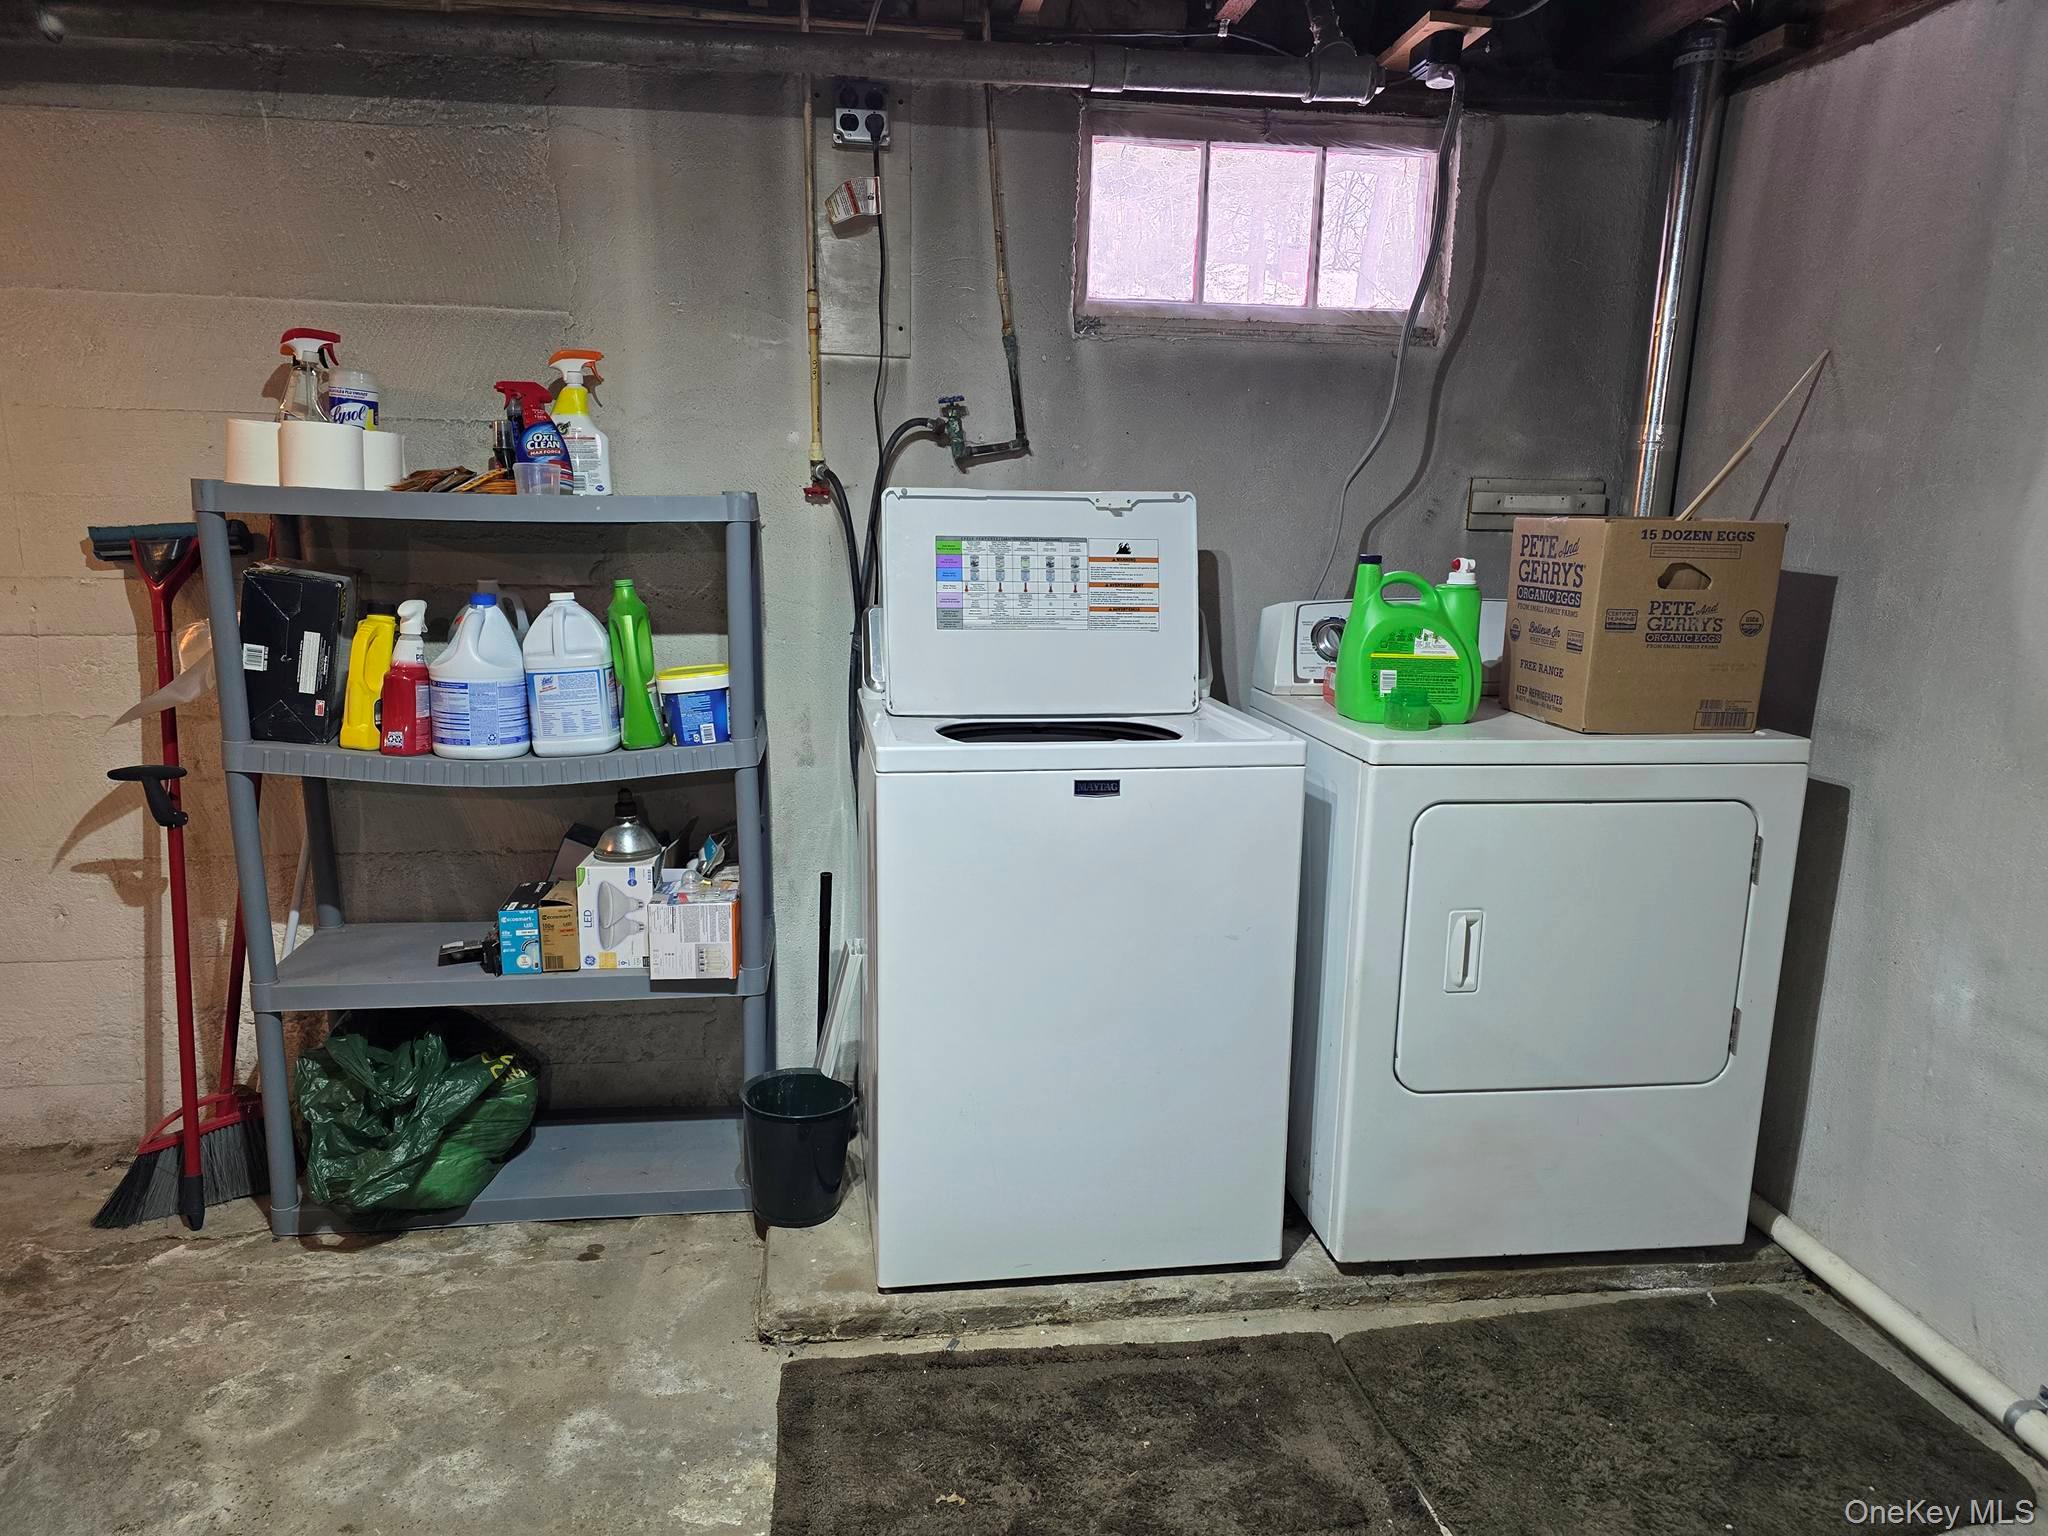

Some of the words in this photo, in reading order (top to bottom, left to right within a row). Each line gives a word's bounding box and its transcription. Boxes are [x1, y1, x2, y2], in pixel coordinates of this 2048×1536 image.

[532, 432, 555, 442] OXI
[526, 440, 560, 450] CLEAN
[1641, 529, 1658, 540] 15
[1661, 530, 1713, 541] DOZEN
[1717, 531, 1756, 542] EGGS
[1520, 534, 1559, 558] PETE
[1558, 537, 1580, 557] And
[1518, 559, 1584, 588] GERRY'S
[1518, 587, 1555, 602] ORGANIC
[1556, 592, 1581, 606] EGGS
[1648, 601, 1697, 616] PETE
[1696, 603, 1719, 616] And
[1646, 617, 1723, 633] GERRY'S
[1647, 635, 1693, 643] ORGANIC
[1694, 634, 1721, 643] EGGS
[1520, 659, 1536, 671] FREE
[1538, 663, 1564, 678] RANGE
[1516, 684, 1528, 695] KEEP
[1077, 782, 1118, 791] MAYTAG
[583, 909, 594, 928] LED
